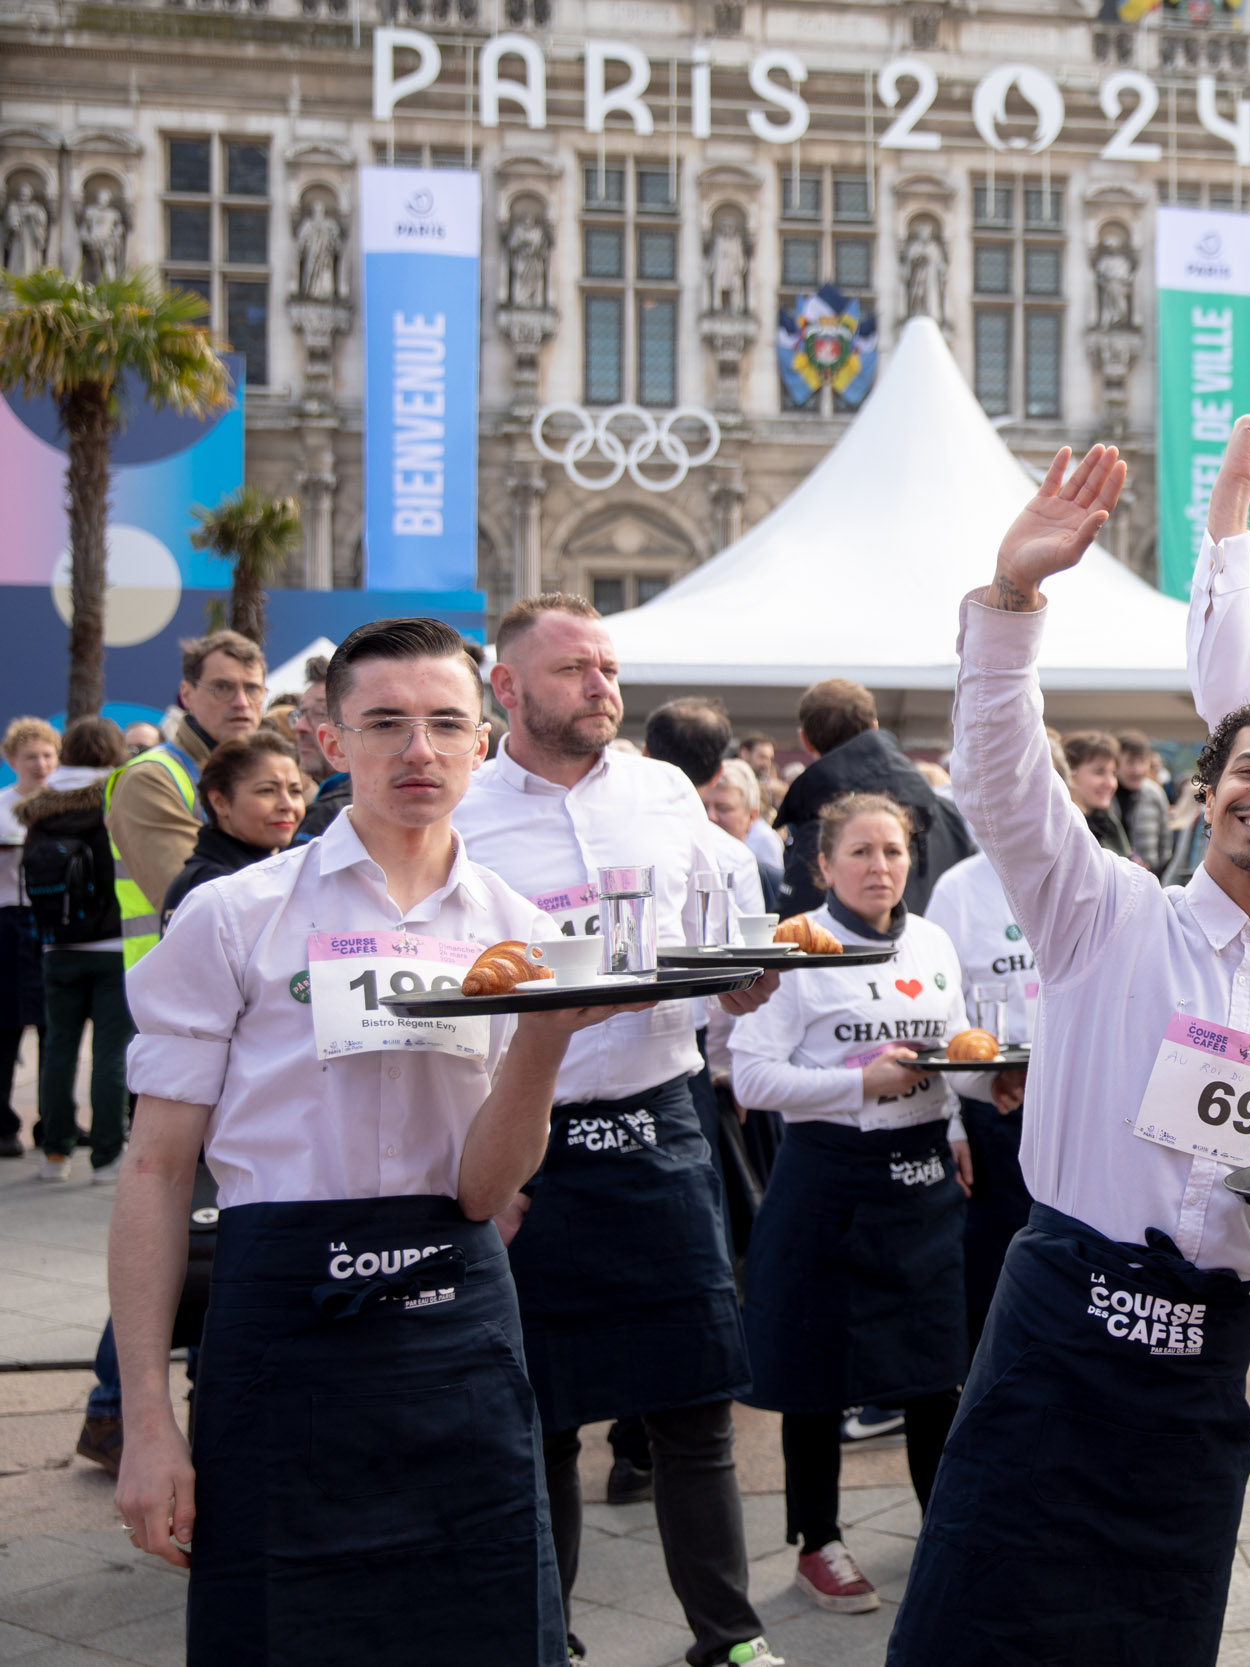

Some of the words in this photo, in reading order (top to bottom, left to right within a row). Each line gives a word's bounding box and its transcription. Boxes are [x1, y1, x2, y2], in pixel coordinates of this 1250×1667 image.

[1191, 306, 1233, 393] VILLE
[393, 311, 446, 536] BIENVENUE
[1191, 398, 1233, 441] DE
[537, 894, 569, 906] COURSE
[331, 937, 377, 948] COURSE
[438, 943, 476, 954] Dimanche
[867, 982, 882, 1000] I
[361, 1018, 395, 1028] Bistro
[397, 1018, 434, 1029] Régent
[436, 1020, 457, 1032] Evry
[834, 1020, 947, 1042] CHARTIE
[1188, 1026, 1229, 1045] COURSE
[1193, 1037, 1227, 1053] CAFÉS
[1165, 1050, 1188, 1065] AU
[1200, 1062, 1222, 1076] ROI
[1230, 1072, 1245, 1082] DU
[568, 1135, 586, 1146] DES
[1143, 1131, 1156, 1140] PARIS
[330, 1242, 348, 1251] LA
[1090, 1273, 1106, 1284] LA
[405, 1300, 417, 1308] PAR
[1090, 1286, 1207, 1325] COURSE
[1087, 1305, 1110, 1319] DES
[1107, 1314, 1204, 1349] CAFÉS
